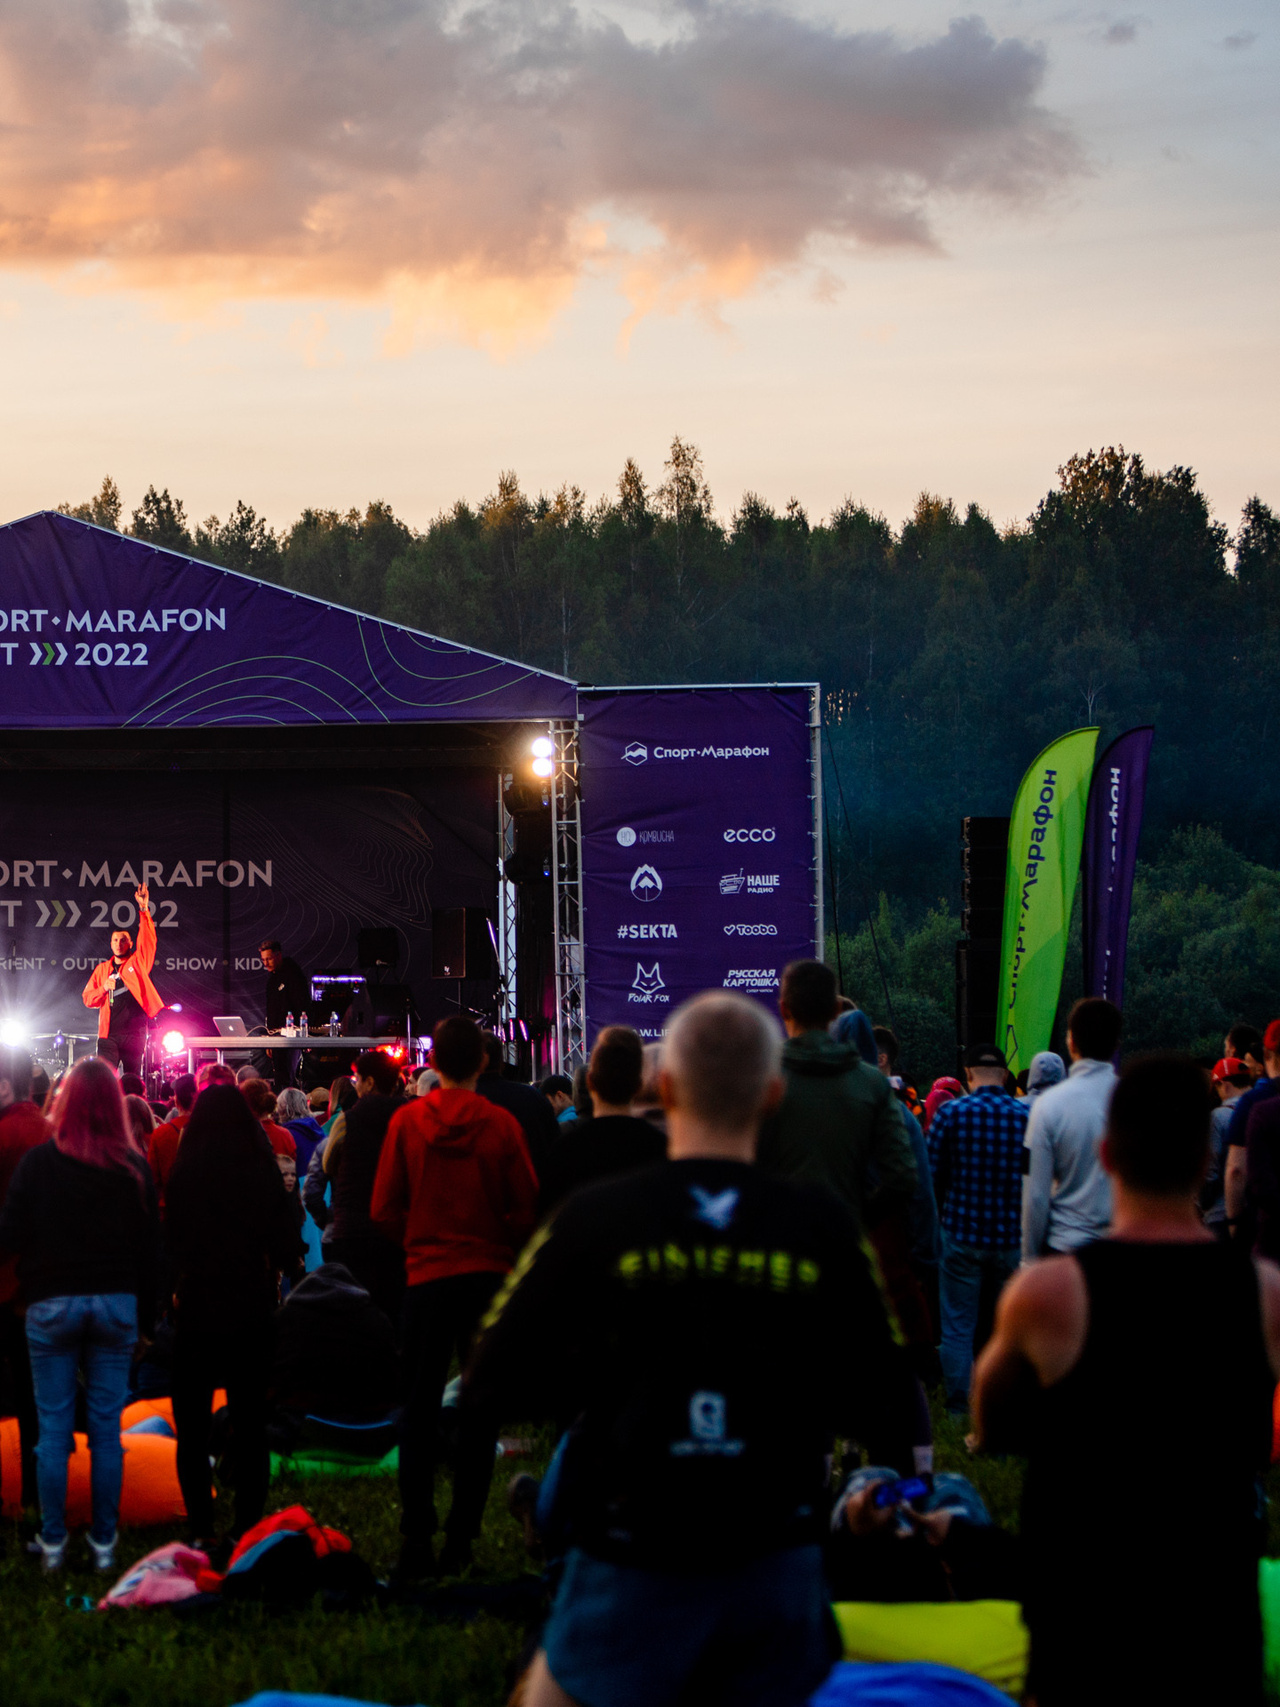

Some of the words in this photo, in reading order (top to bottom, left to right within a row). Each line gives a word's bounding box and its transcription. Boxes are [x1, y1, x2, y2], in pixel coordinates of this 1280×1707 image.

[74, 642, 149, 666] 2022
[747, 875, 780, 886] НАШЕ
[89, 900, 179, 928] 2022
[617, 924, 678, 939] #SEKTA
[166, 957, 218, 971] SHOW
[727, 968, 776, 978] РУССКАЯ
[722, 978, 779, 987] КАРТОШКА
